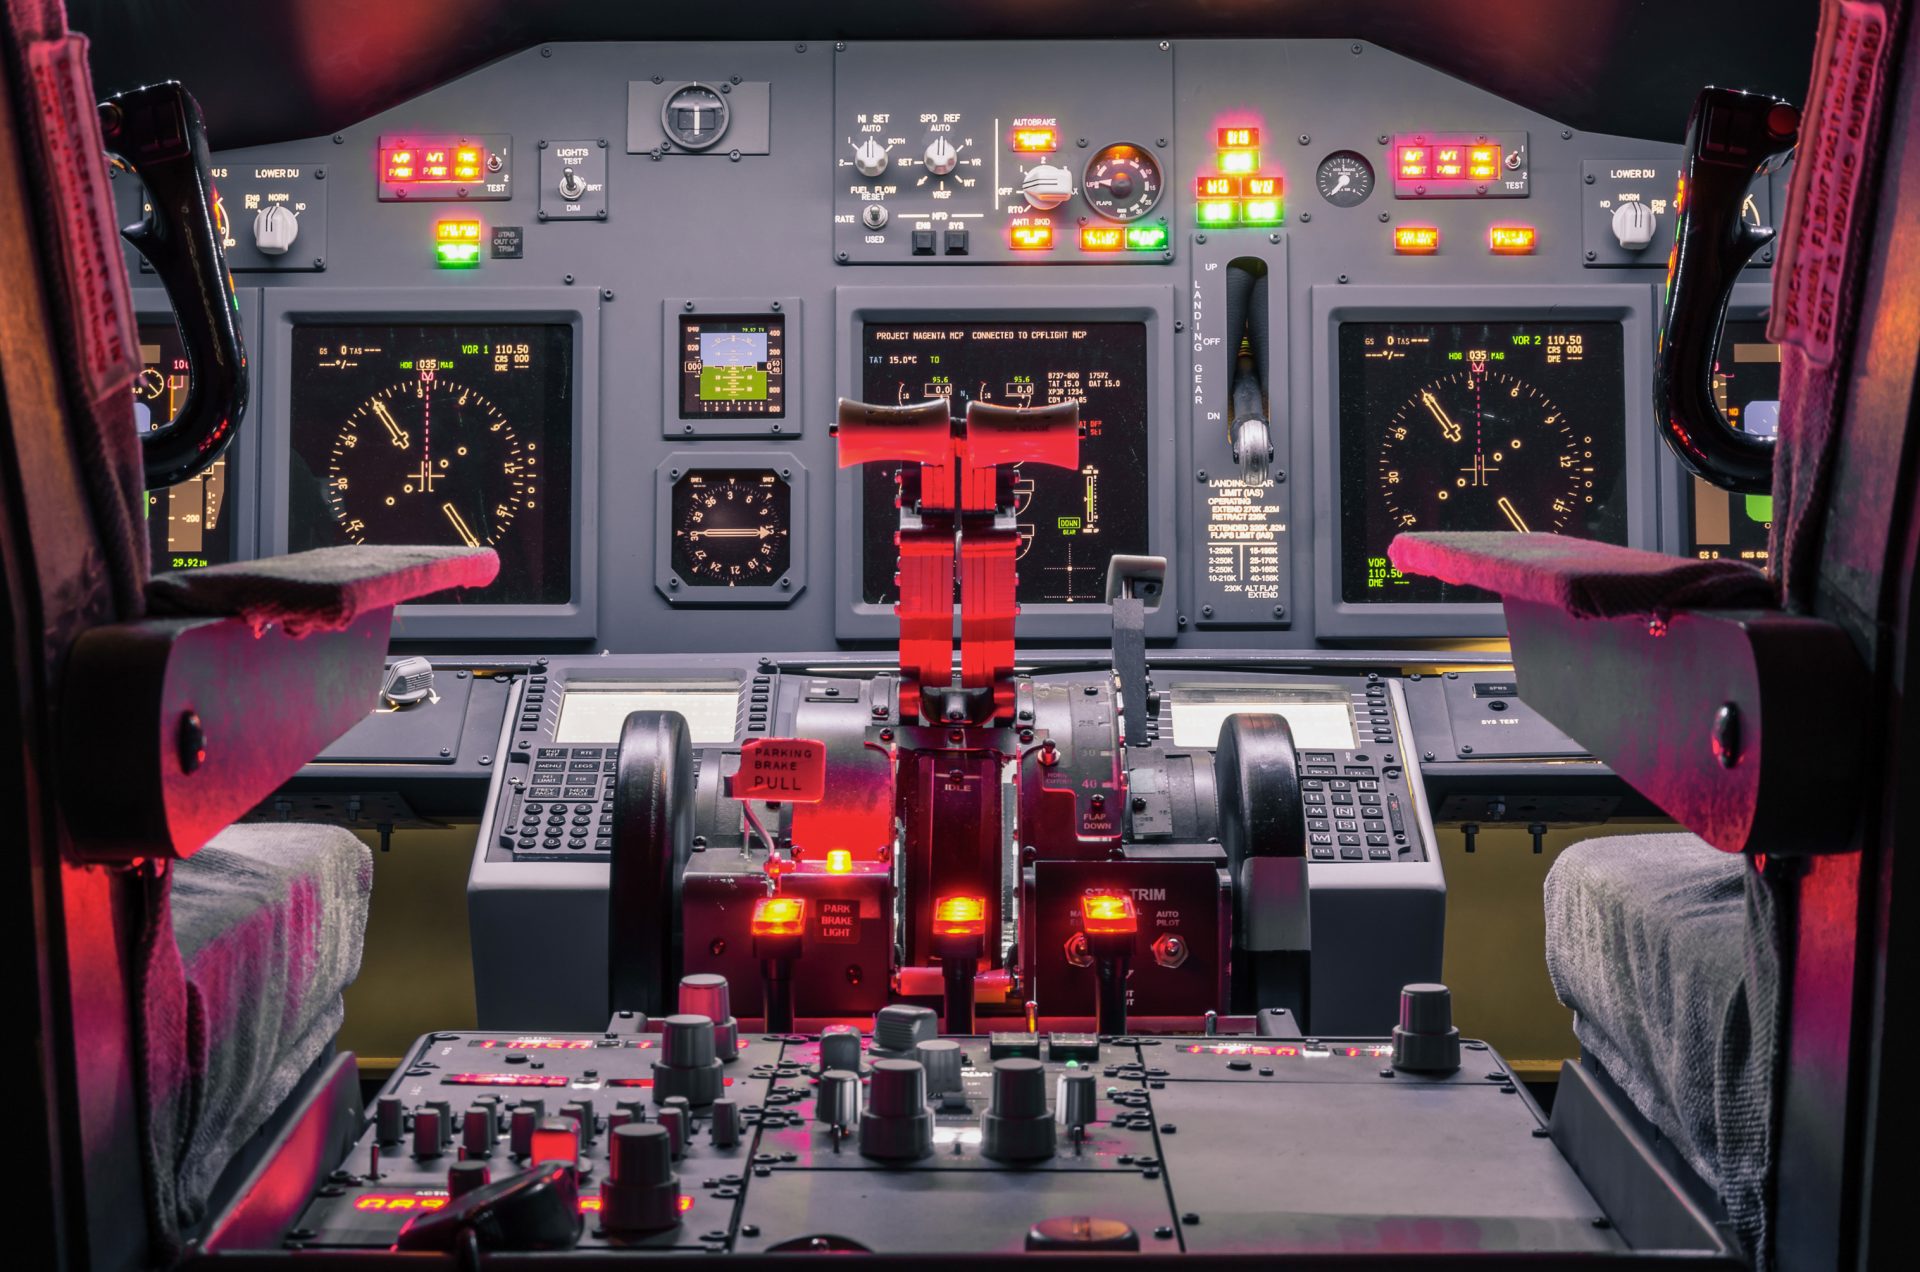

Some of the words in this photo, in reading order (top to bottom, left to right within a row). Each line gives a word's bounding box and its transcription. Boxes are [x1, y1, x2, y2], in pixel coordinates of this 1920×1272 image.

[255, 169, 285, 178] LOWER
[287, 169, 300, 178] DU
[503, 174, 509, 182] 2
[1643, 170, 1655, 178] DU
[486, 184, 506, 192] TEST
[245, 194, 260, 202] ENG
[268, 193, 289, 202] NORM
[295, 203, 306, 211] ND
[1194, 280, 1202, 351] LANDING
[1815, 286, 1836, 344] SEAT
[1513, 336, 1530, 345] VOR
[1535, 336, 1541, 345] 2
[1547, 336, 1582, 345] 110.50
[462, 345, 478, 354] VOR
[496, 345, 529, 354] 110.50
[1469, 351, 1486, 360] 035
[420, 360, 436, 369] 035
[1194, 364, 1202, 404] GEAR
[1388, 472, 1399, 484] 30
[1244, 489, 1264, 498] (IAS)
[172, 559, 198, 567] 29.92
[1368, 559, 1386, 567] VOR
[1368, 579, 1383, 587] DME
[755, 748, 812, 758] PARKING
[754, 761, 797, 770] BRAKE
[754, 776, 802, 791] PULL
[1082, 780, 1097, 788] 40
[1129, 889, 1166, 900] TRIM
[822, 916, 853, 925] BRAKE
[824, 928, 850, 936] LIGHT
